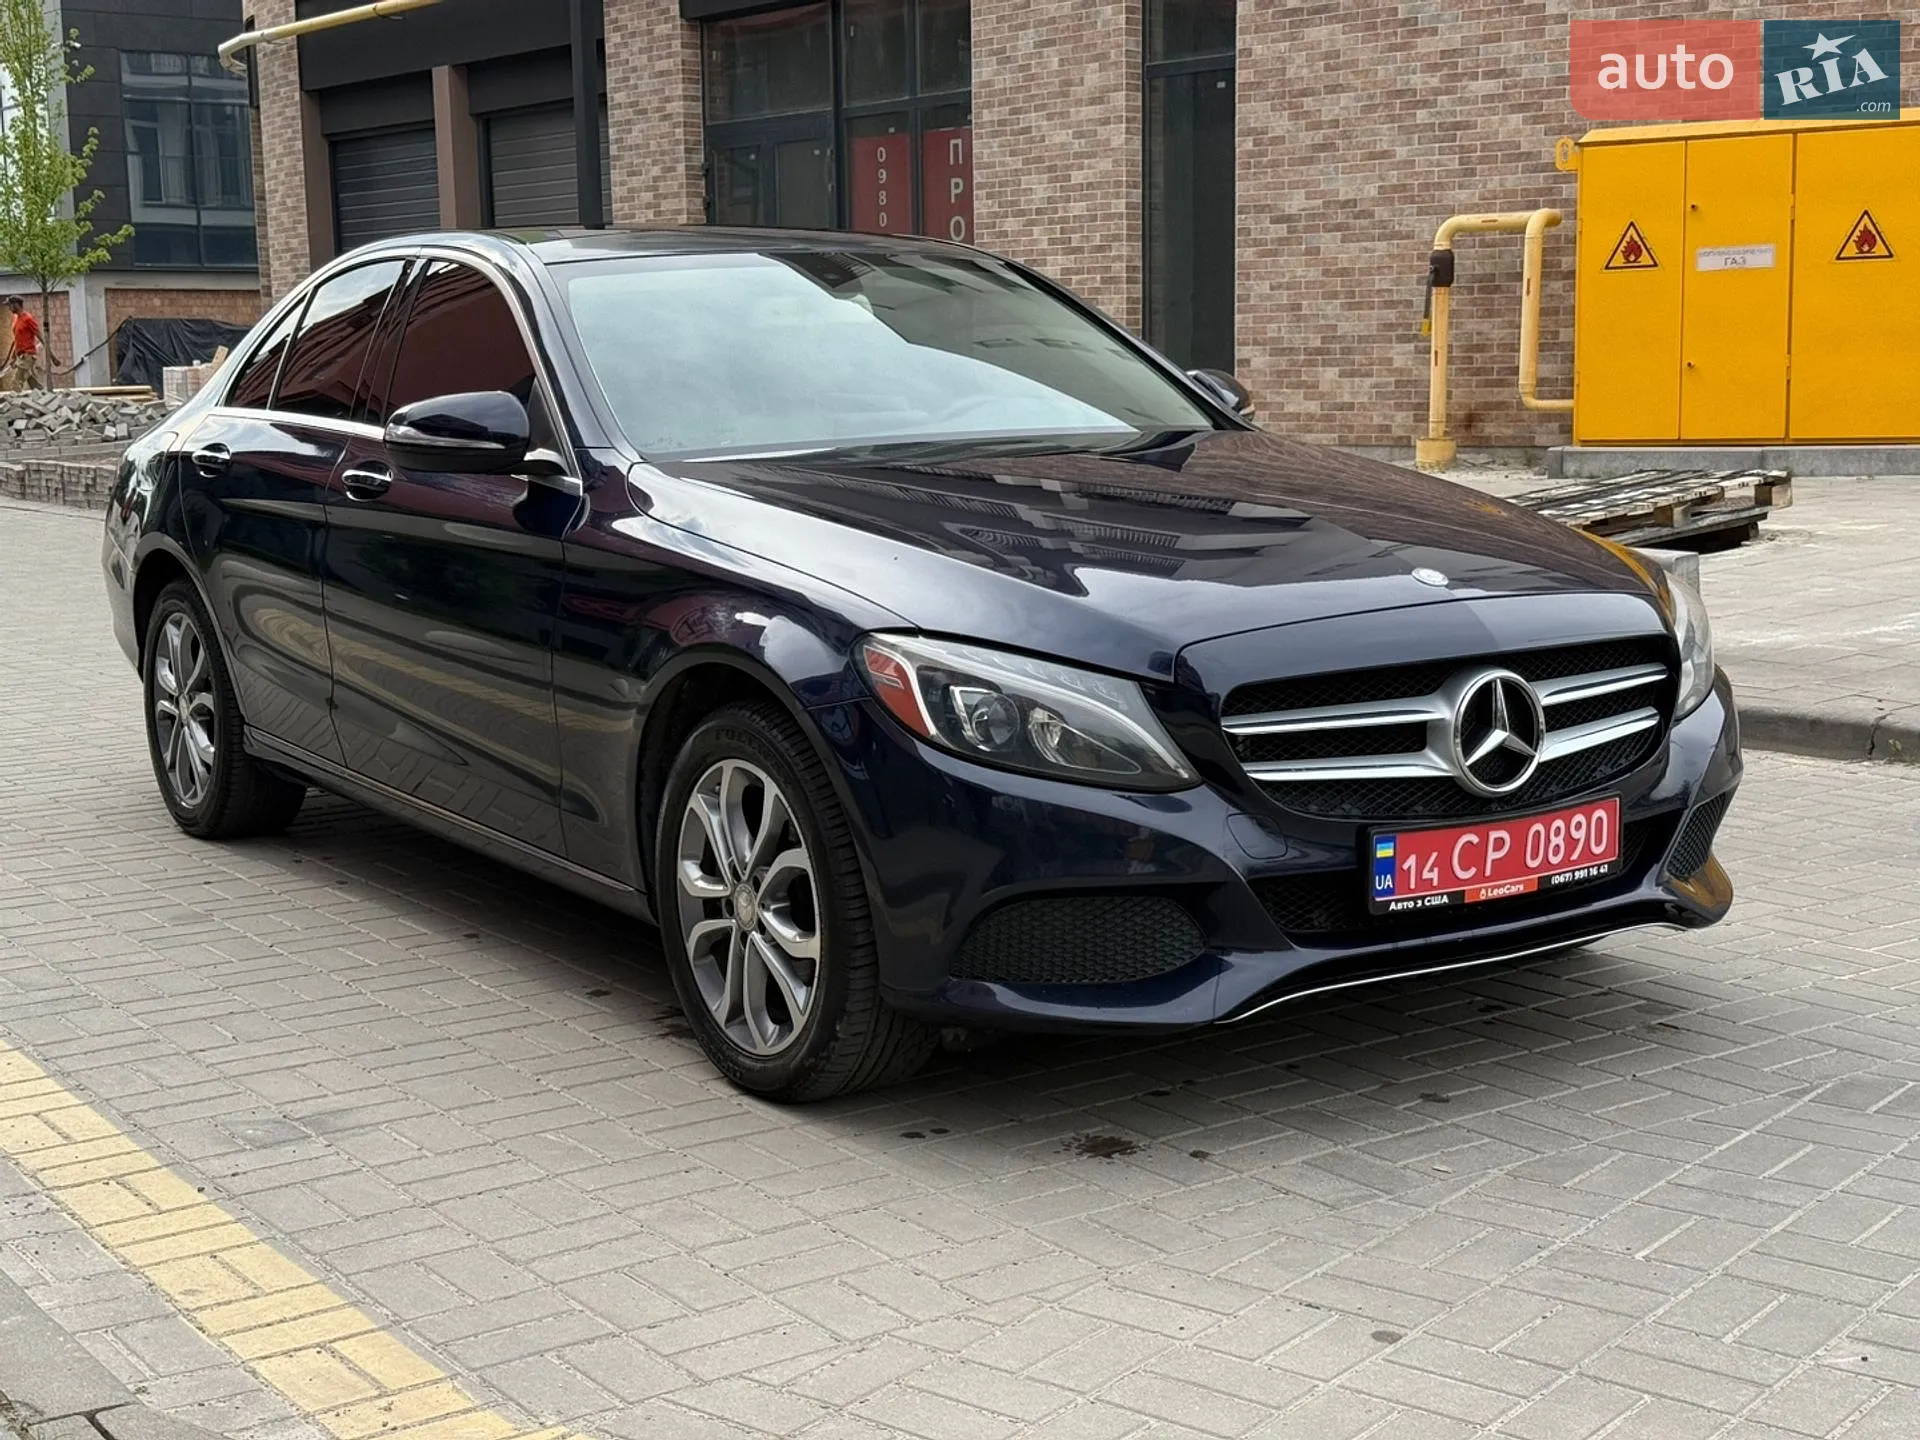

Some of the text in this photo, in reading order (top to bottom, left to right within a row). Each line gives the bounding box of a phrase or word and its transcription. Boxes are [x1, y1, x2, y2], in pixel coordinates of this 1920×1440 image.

[1724, 256, 1747, 266] ГАЗ
[1401, 809, 1608, 889] 14 CP 0890
[1375, 874, 1394, 890] UA
[1551, 872, 1573, 885] (067)
[1574, 868, 1588, 880] 991
[1486, 883, 1524, 898] LeoCars
[1389, 900, 1415, 911] Авто
[1424, 894, 1449, 907] США
